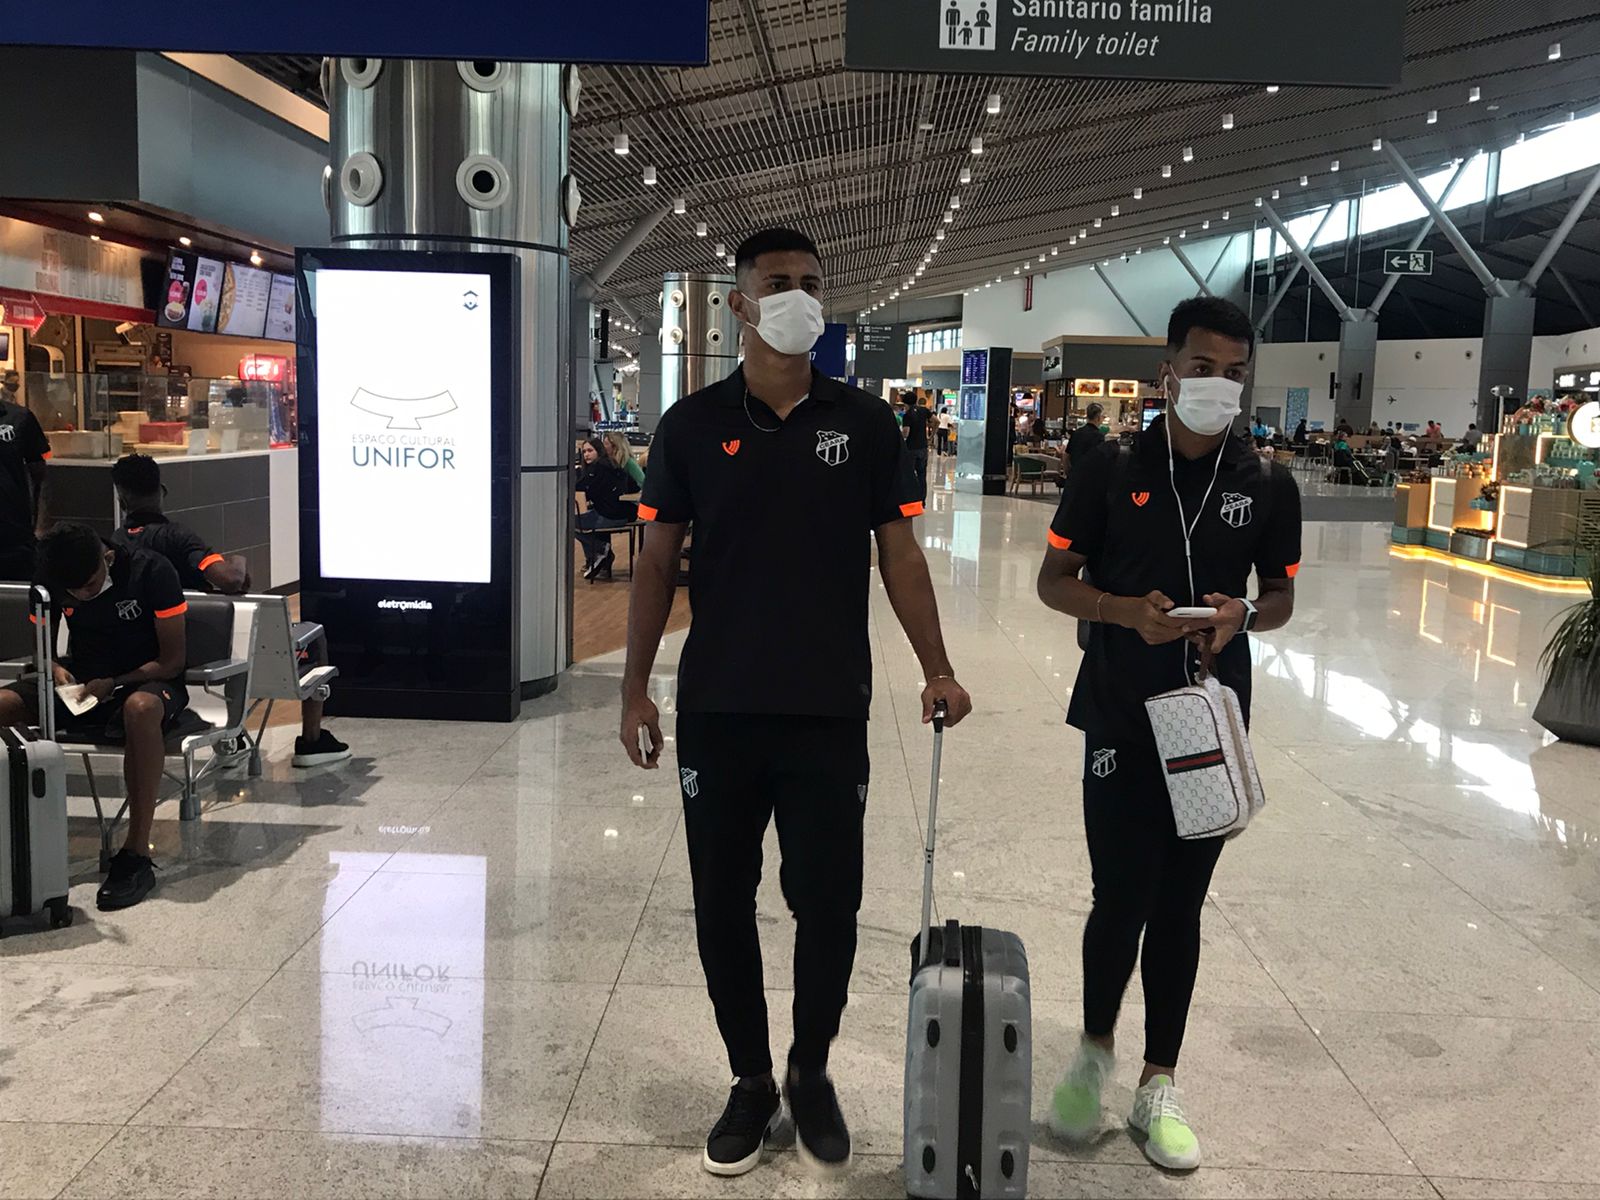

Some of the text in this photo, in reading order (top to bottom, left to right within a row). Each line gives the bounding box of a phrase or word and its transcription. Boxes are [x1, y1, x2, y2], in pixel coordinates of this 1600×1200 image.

[1130, 0, 1212, 23] família
[1011, 27, 1159, 59] Family toilet
[400, 435, 456, 447] CULTURAL
[352, 445, 455, 469] UNIFOR
[377, 599, 432, 611] eletromidia
